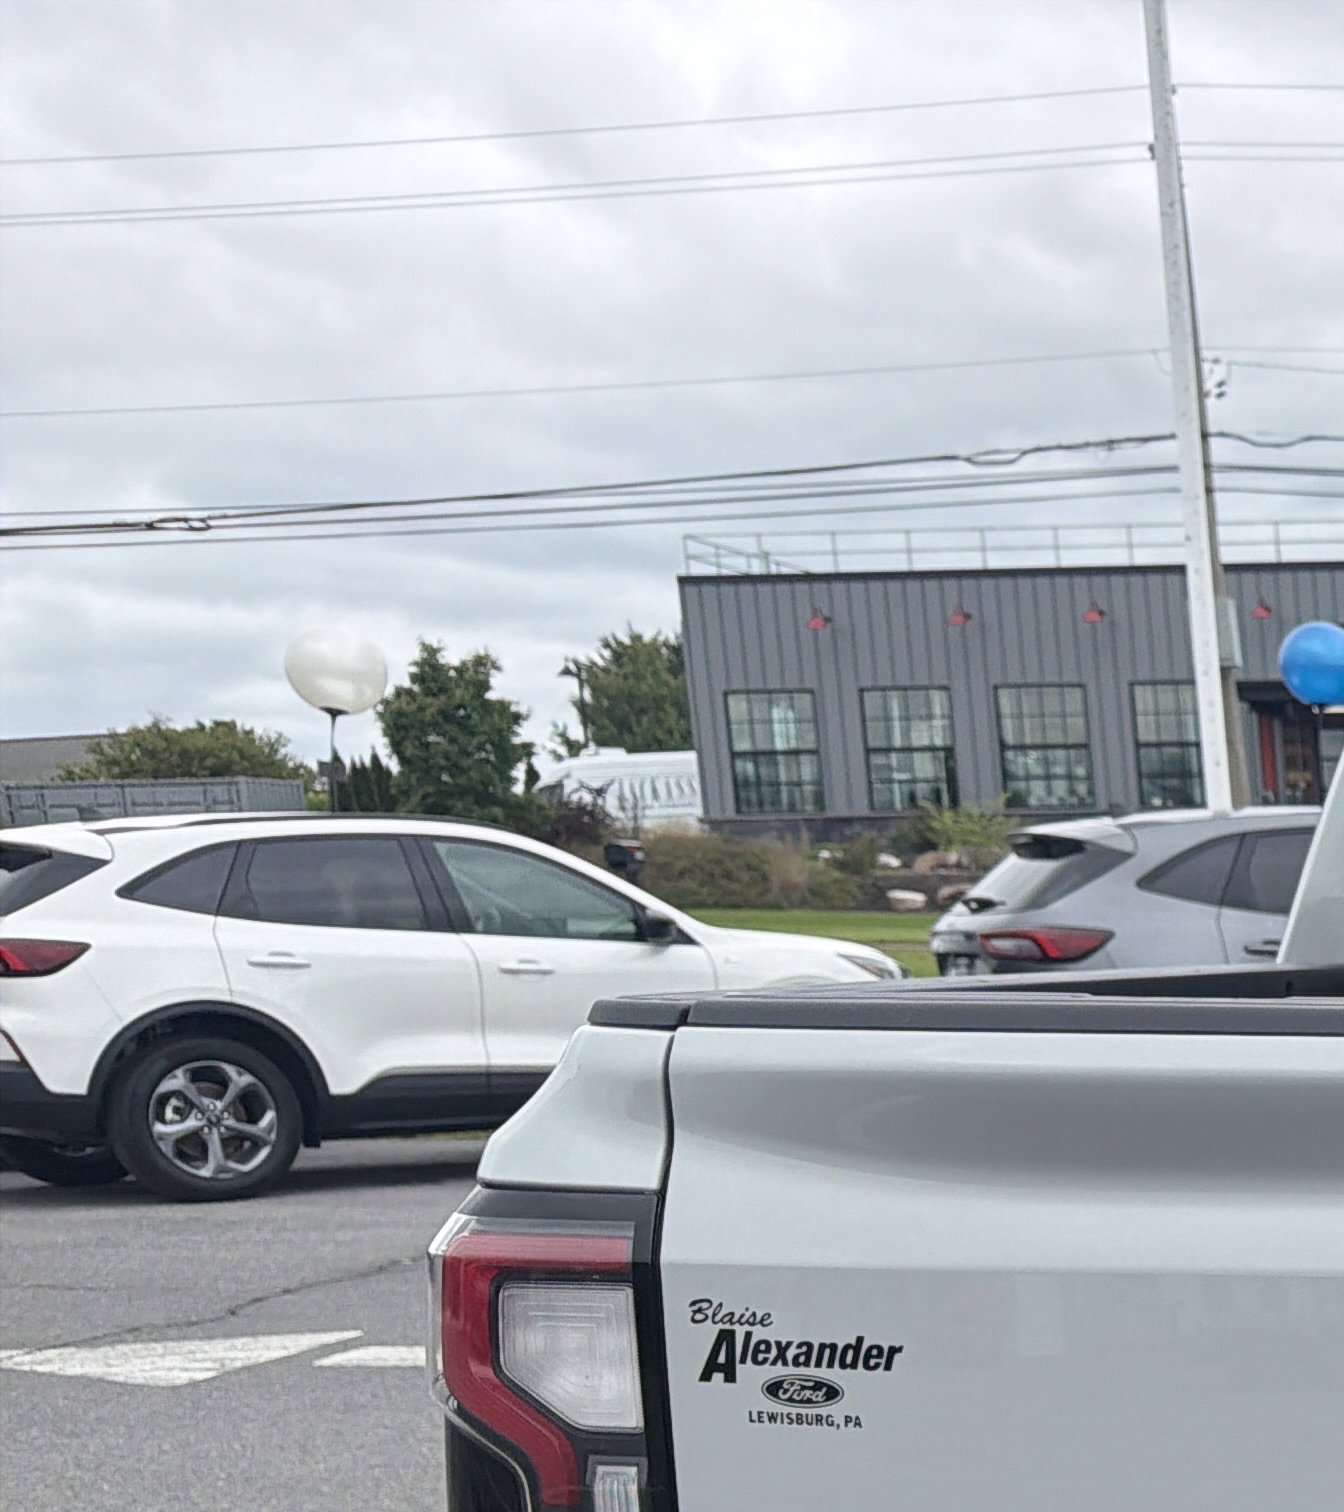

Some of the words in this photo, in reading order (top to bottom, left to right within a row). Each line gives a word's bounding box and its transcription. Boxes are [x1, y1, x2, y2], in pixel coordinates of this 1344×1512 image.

[688, 1298, 774, 1328] Blaise
[698, 1328, 904, 1384] Alexander
[777, 1378, 828, 1402] Ford
[748, 1410, 841, 1430] LEWISBURG,
[844, 1415, 863, 1429] PA
